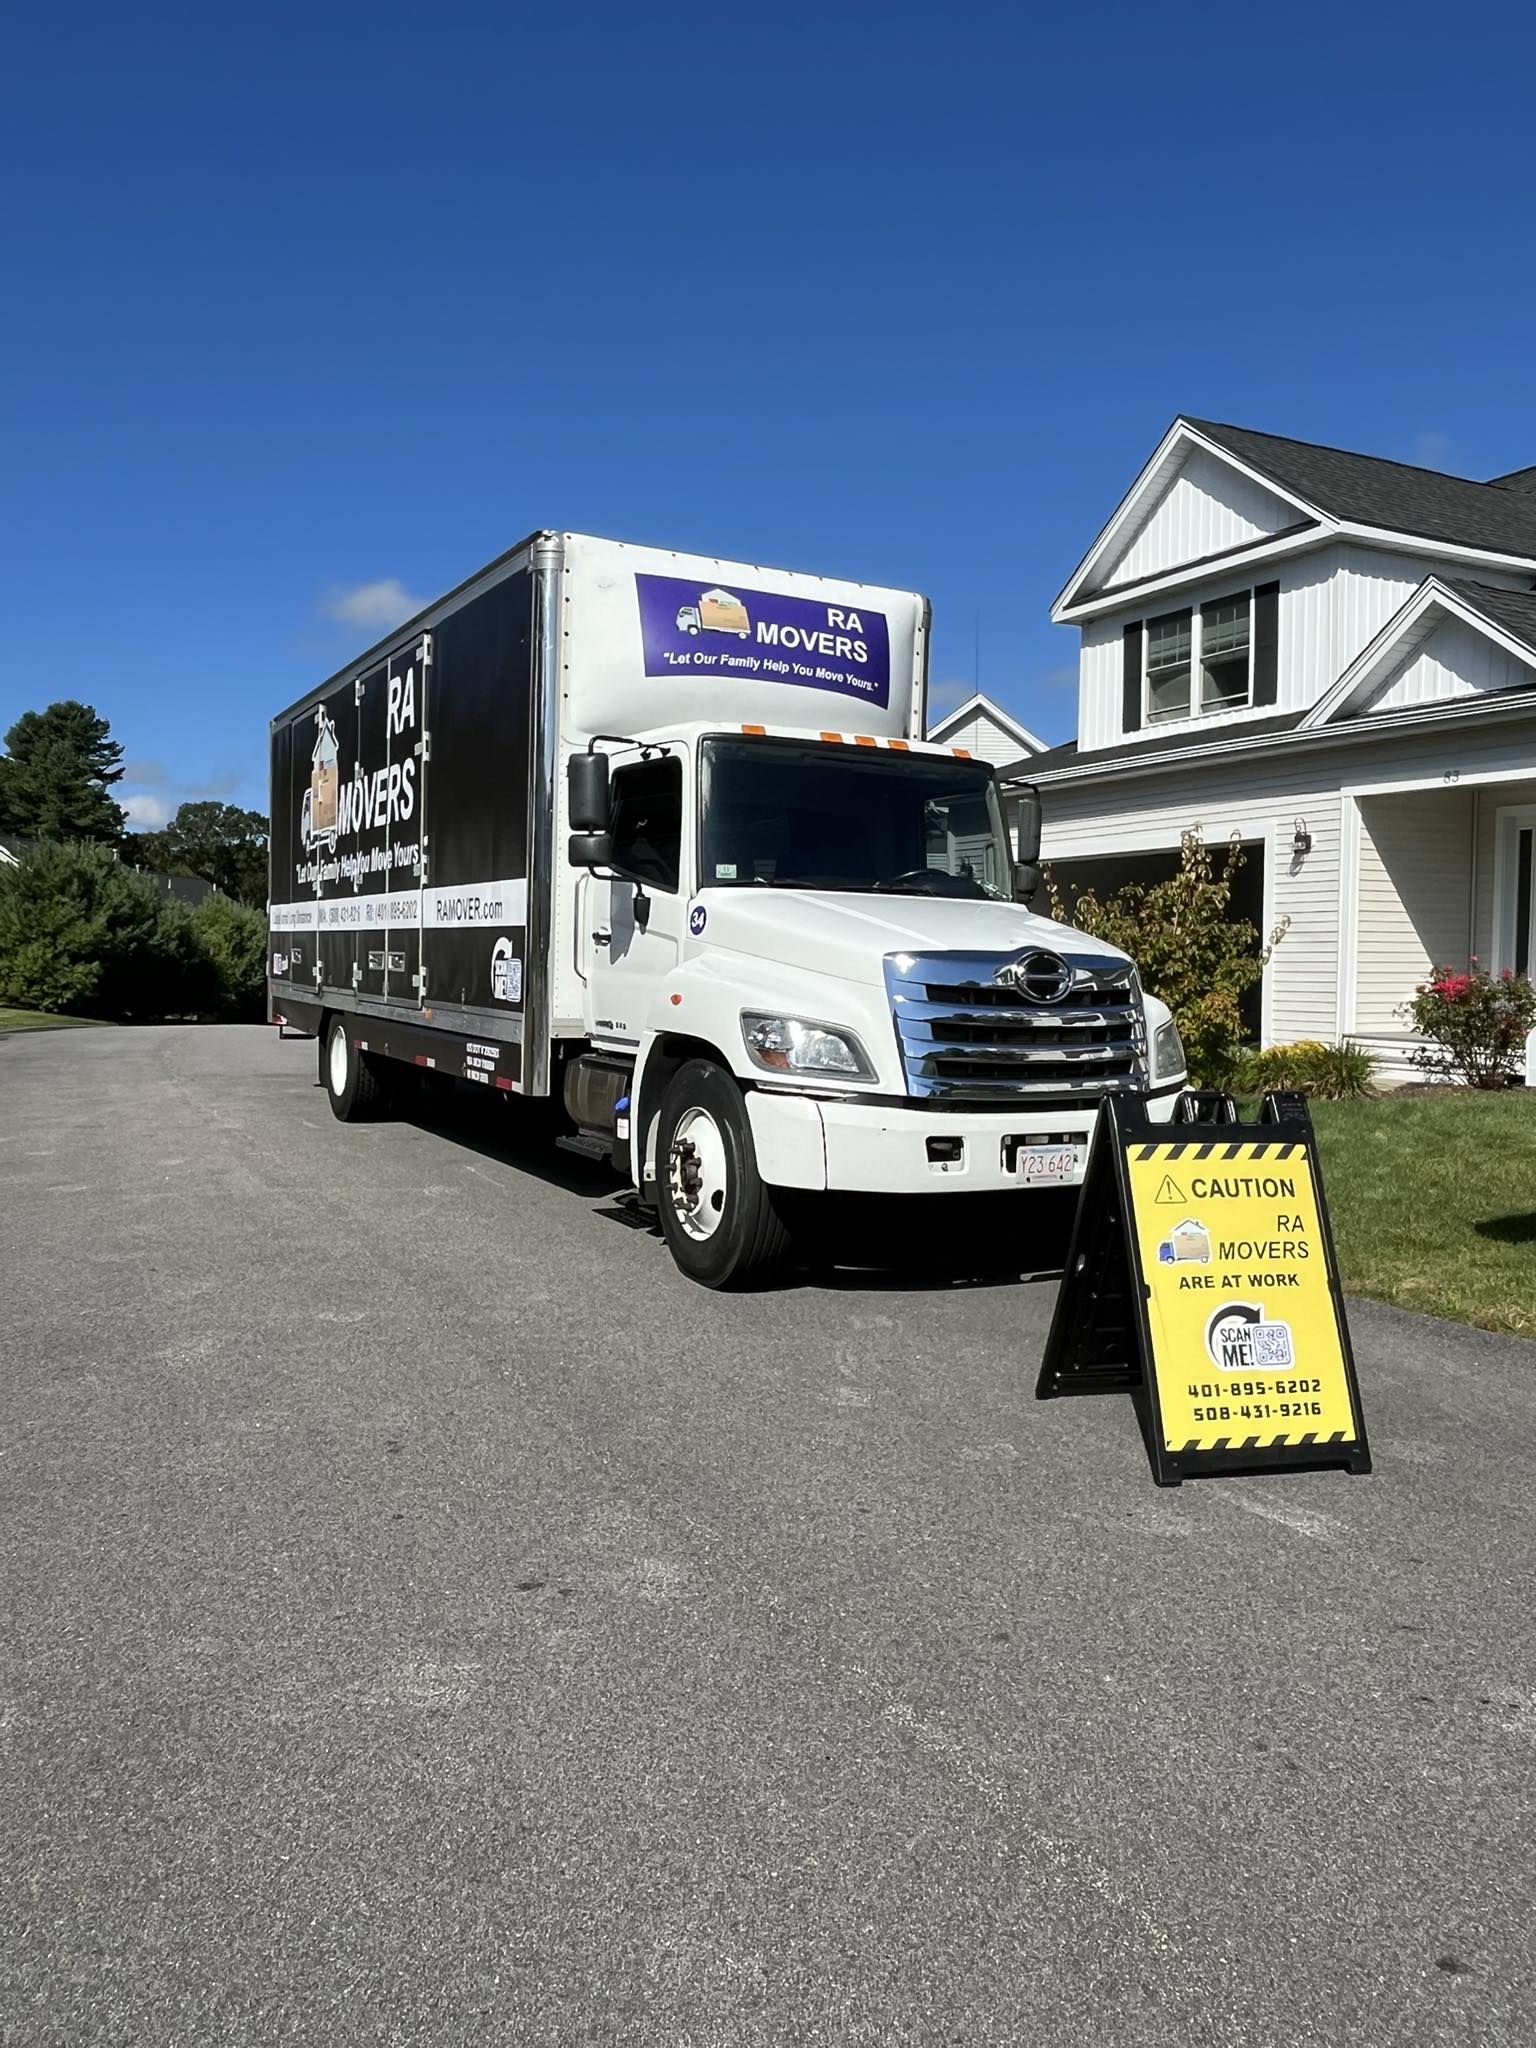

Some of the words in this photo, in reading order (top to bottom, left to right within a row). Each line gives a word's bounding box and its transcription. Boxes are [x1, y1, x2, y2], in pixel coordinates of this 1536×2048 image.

[827, 608, 863, 633] RA
[757, 622, 868, 663] MOVERS
[693, 652, 717, 665] Our
[720, 654, 760, 671] Family
[763, 659, 789, 674] Help
[792, 663, 813, 677] You
[816, 668, 843, 682] Move
[387, 667, 415, 738] RA
[1443, 770, 1460, 784] 83
[338, 757, 416, 836] MOVERS
[356, 850, 370, 873] You
[371, 846, 393, 872] Move
[436, 897, 503, 921] RAMOVER.com
[691, 911, 705, 928] 34
[1048, 1154, 1071, 1173] 642
[1191, 1178, 1296, 1198] CAUTION
[1277, 1215, 1304, 1233] RA
[1219, 1241, 1309, 1260] MOVERS
[1179, 1275, 1215, 1290] ARE
[1221, 1274, 1243, 1288] AT
[1247, 1273, 1299, 1287] WORK
[1220, 1327, 1251, 1343] SCAN
[1222, 1343, 1255, 1368] ME!
[1188, 1379, 1321, 1398] 401-895-6202
[1193, 1402, 1321, 1421] 508-431-9216
